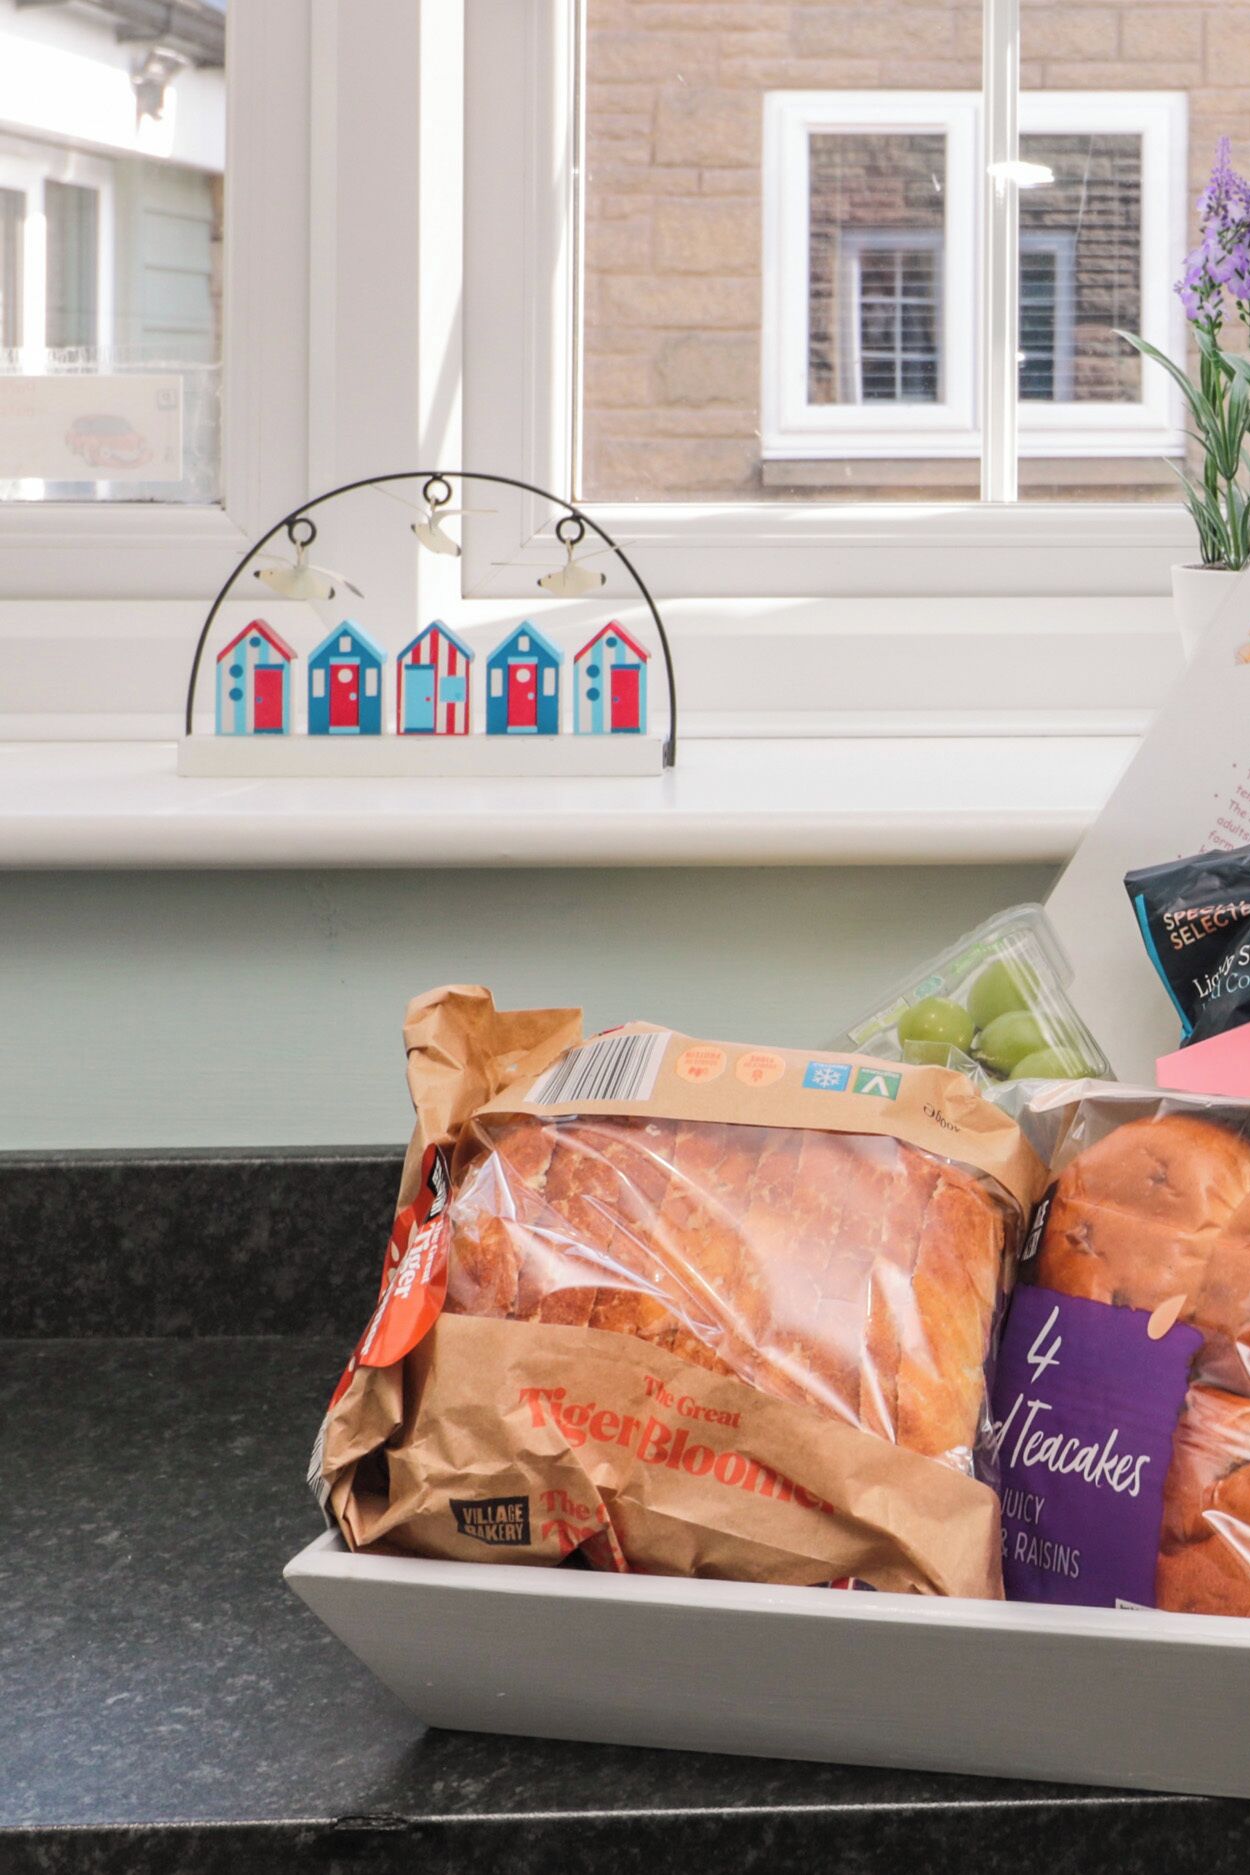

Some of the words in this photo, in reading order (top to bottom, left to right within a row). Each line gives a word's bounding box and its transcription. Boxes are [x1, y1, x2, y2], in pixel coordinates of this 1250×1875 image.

[1228, 798, 1248, 818] The
[1027, 1305, 1062, 1384] 4
[643, 1375, 674, 1408] The
[676, 1395, 742, 1429] Great
[1010, 1399, 1151, 1498] Teacakes
[463, 1503, 524, 1525] VILLAGE
[540, 1489, 591, 1521] The
[465, 1523, 524, 1542] BAKERY
[1014, 1531, 1081, 1579] RAISINS
